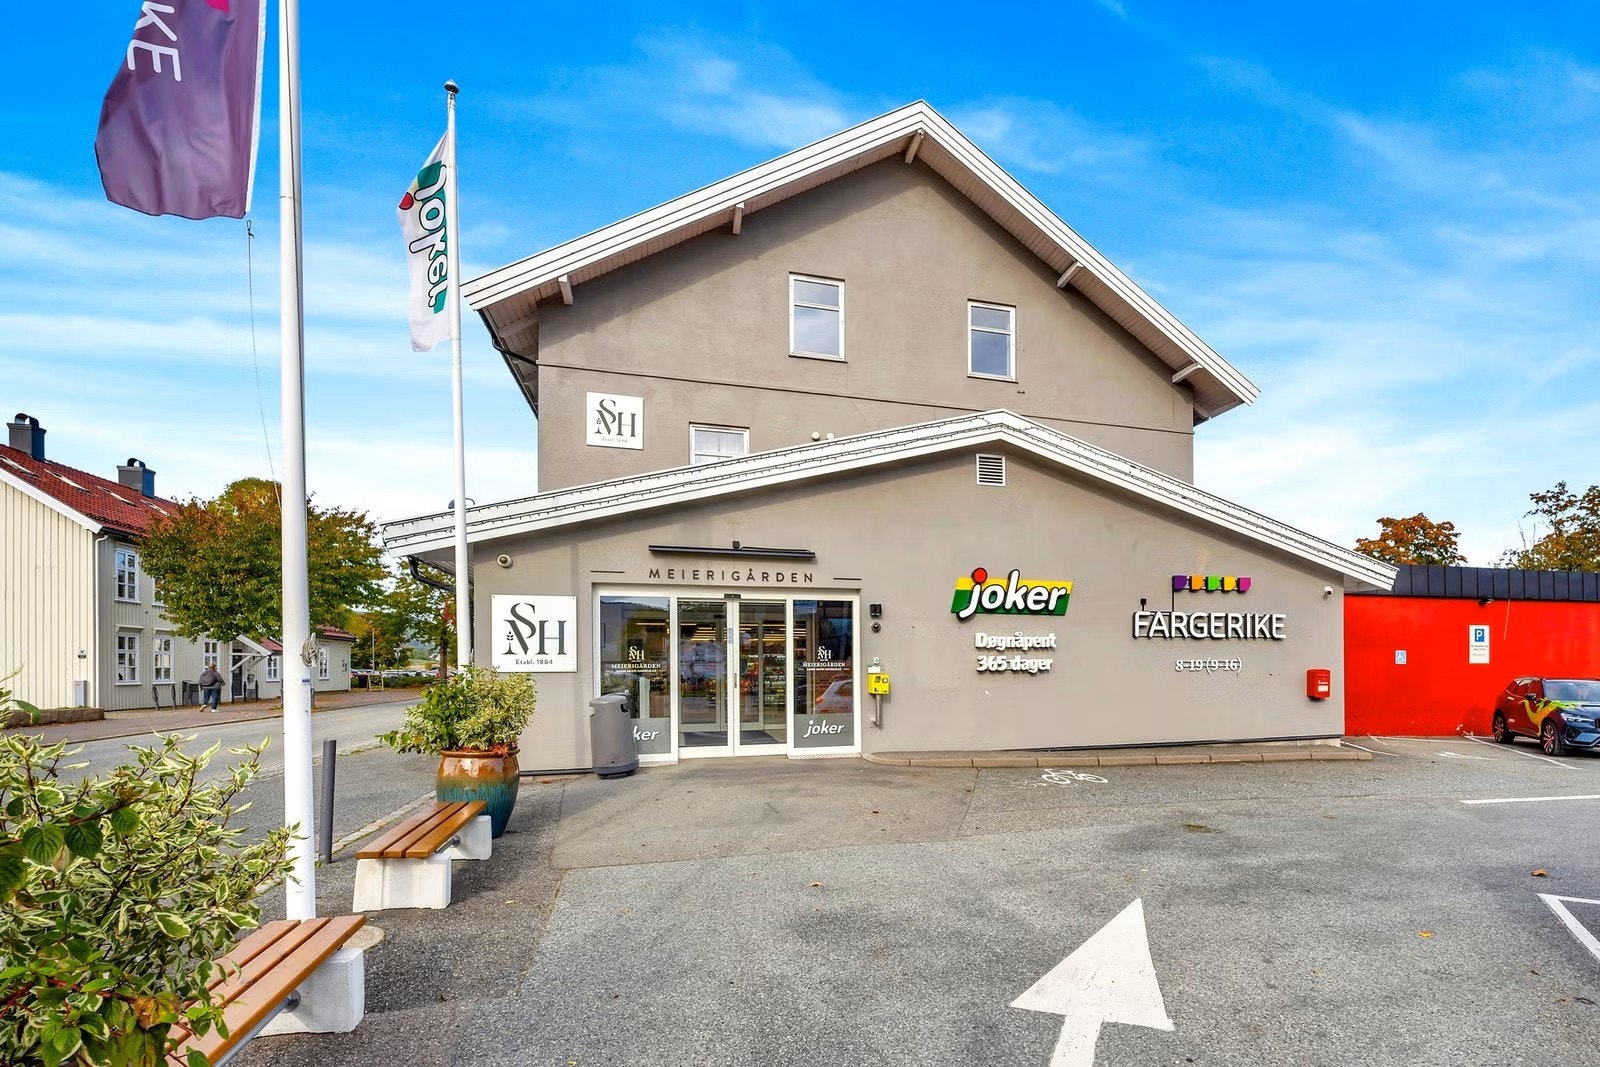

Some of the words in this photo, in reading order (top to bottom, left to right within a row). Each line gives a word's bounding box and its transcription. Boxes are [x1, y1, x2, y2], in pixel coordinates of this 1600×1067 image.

[648, 568, 814, 583] MEIERIGÅRDEN
[957, 567, 1067, 621] joker
[1133, 611, 1287, 639] FARGERIKE
[975, 631, 1057, 651] Døgnåpent
[976, 655, 1007, 672] 365
[1009, 655, 1053, 674] dager
[633, 725, 660, 741] ker
[803, 720, 845, 738] joker
